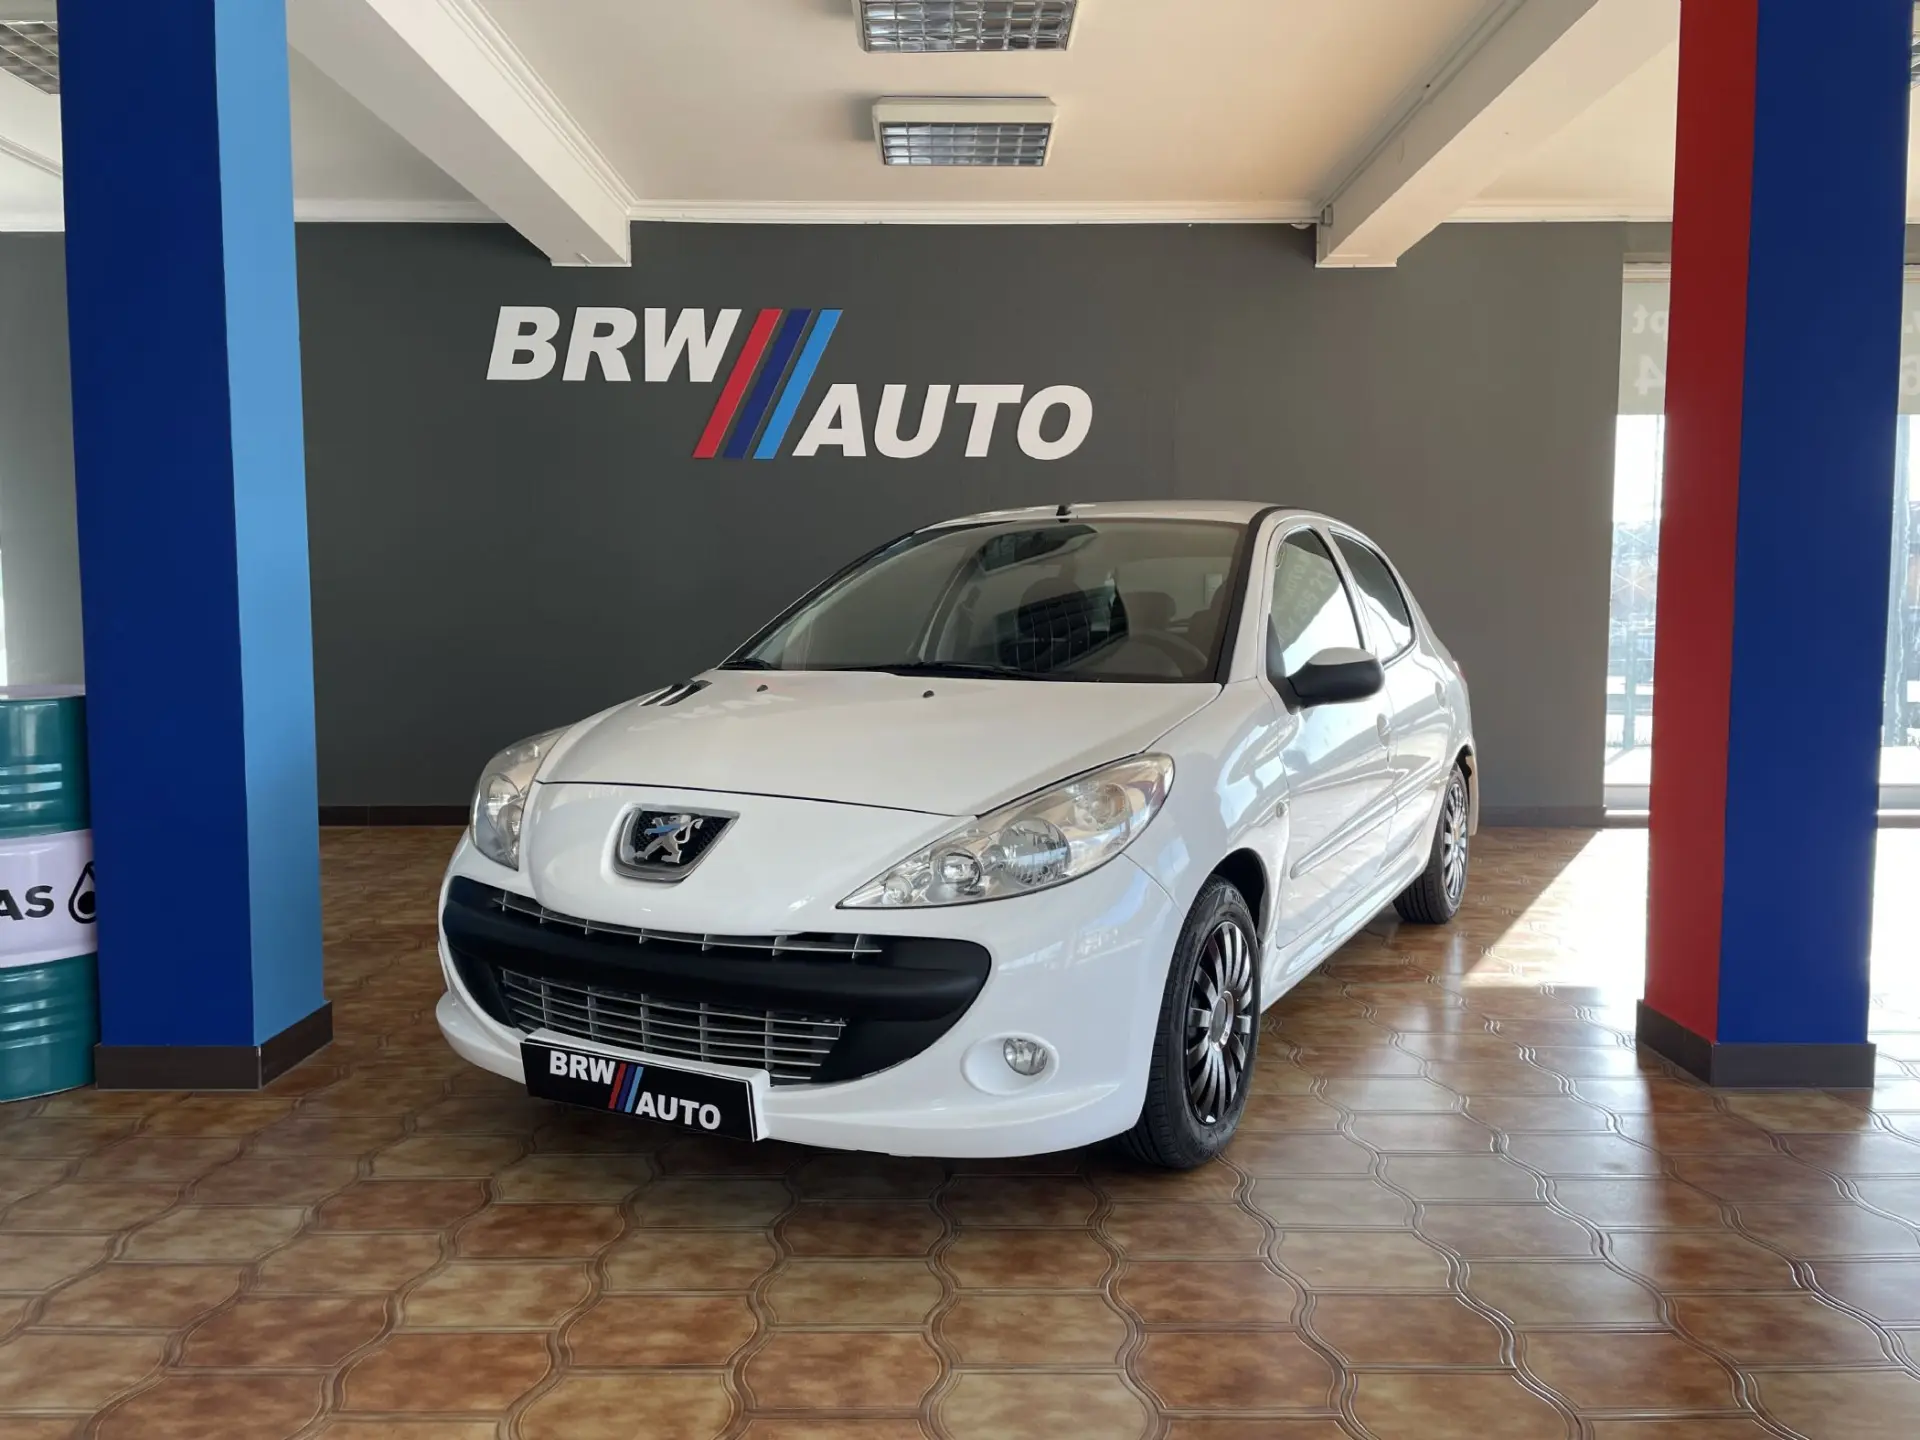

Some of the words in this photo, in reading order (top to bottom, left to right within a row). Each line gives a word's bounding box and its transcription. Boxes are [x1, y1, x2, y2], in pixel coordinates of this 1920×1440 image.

[486, 306, 742, 382] BRW
[792, 383, 1093, 460] AUTO
[549, 1050, 616, 1085] BRW
[635, 1091, 721, 1130] AUTO
